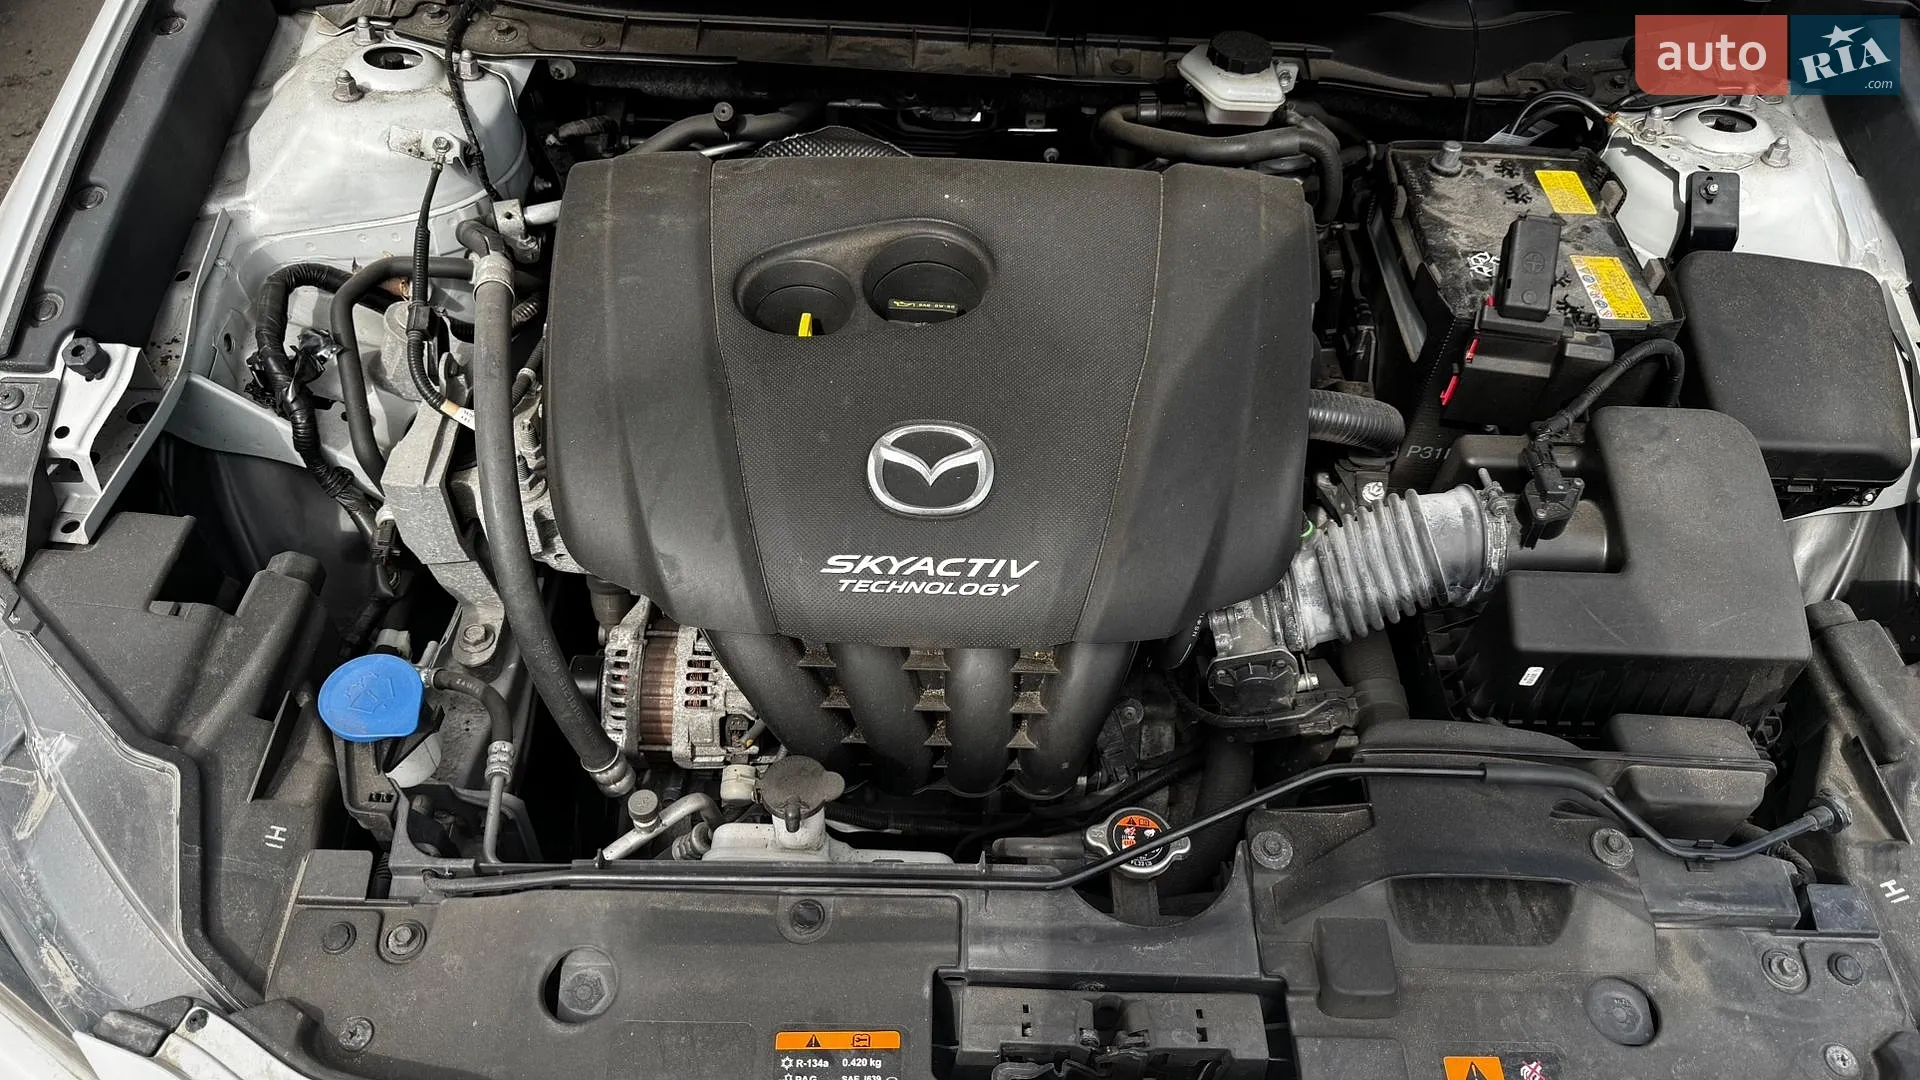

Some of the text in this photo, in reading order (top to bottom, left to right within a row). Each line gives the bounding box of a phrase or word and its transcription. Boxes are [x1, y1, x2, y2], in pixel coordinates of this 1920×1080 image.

[820, 554, 1040, 579] SKYACTIV
[838, 579, 1020, 597] TECHNOLOGY
[796, 1058, 882, 1069] R-134a 0.420 kg
